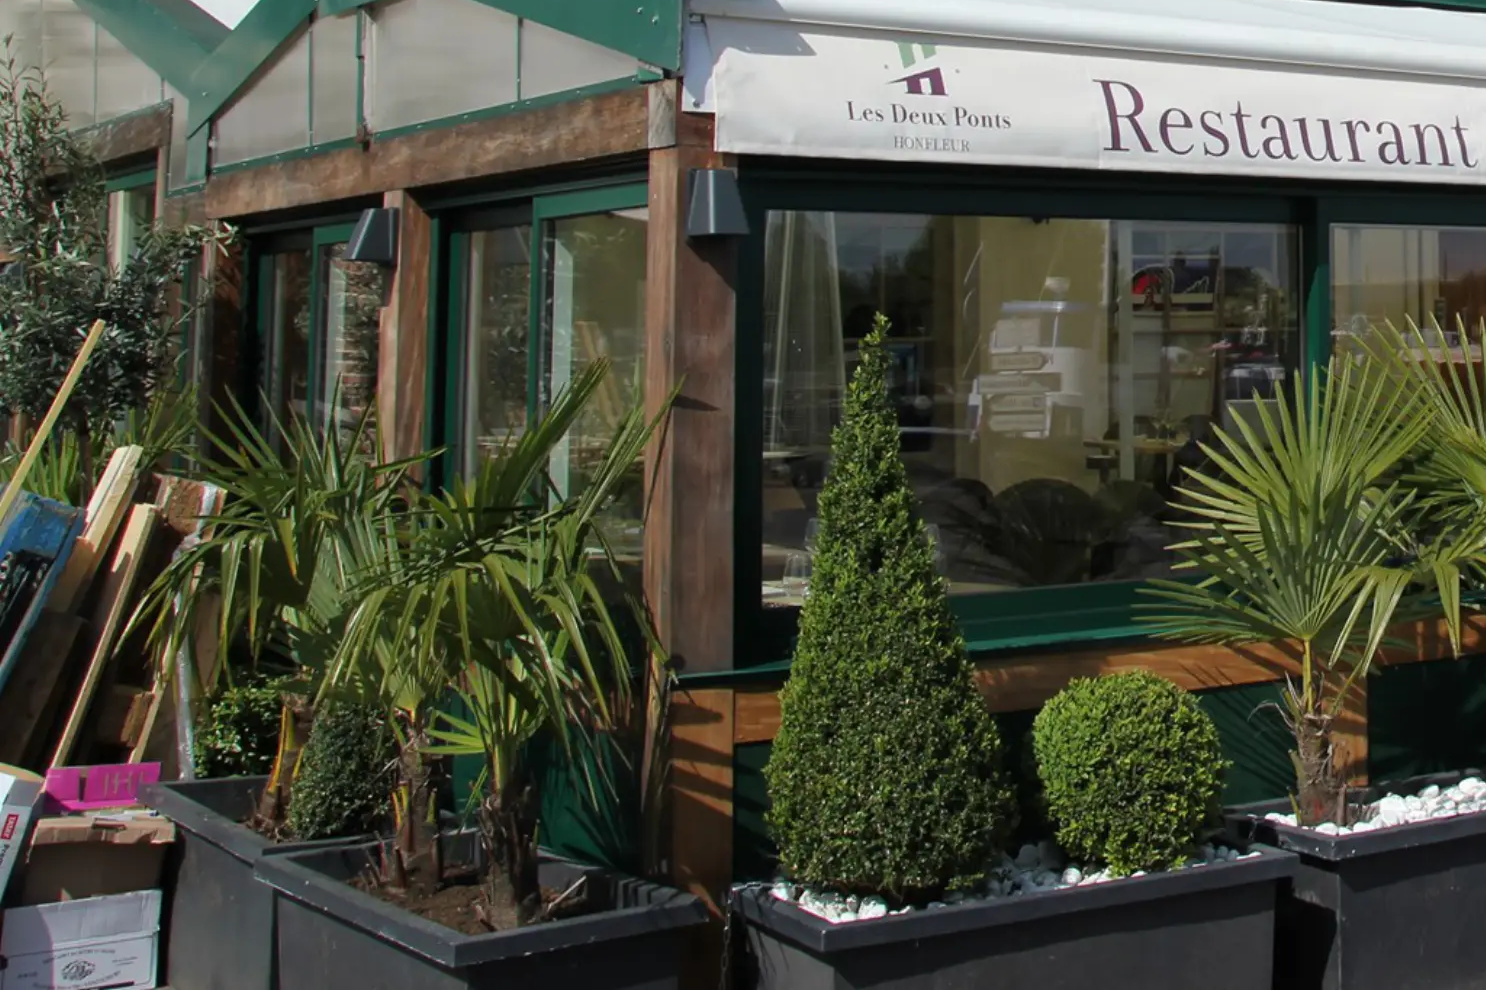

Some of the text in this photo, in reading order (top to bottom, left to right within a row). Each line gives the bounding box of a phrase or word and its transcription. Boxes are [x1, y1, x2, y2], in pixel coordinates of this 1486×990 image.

[845, 100, 1012, 129] Les Deux Ponts
[1091, 78, 1480, 169] Restaurant
[894, 136, 970, 153] HONFLEUR
